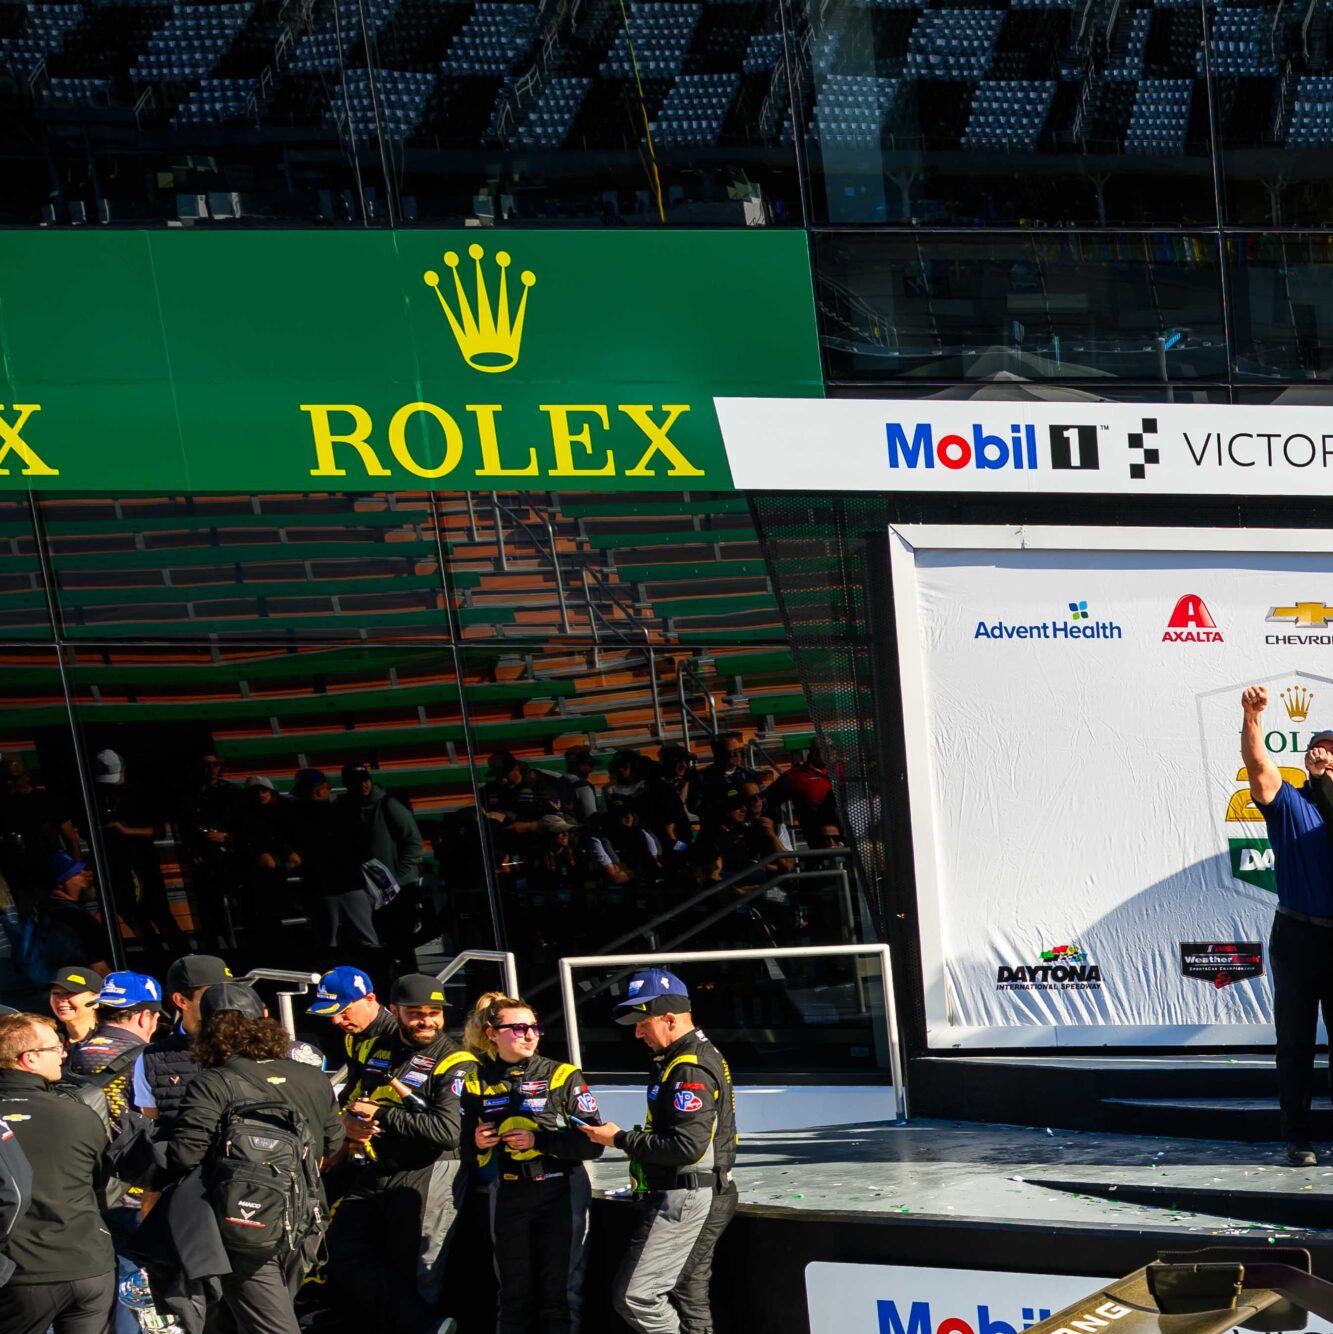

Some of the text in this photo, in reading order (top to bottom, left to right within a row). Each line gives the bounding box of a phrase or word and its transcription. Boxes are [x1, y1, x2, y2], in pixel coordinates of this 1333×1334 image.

[300, 402, 705, 478] ROLEX
[886, 423, 1091, 471] Mobil 1
[1161, 631, 1223, 643] AXALTA
[997, 965, 1102, 983] DAYTONA
